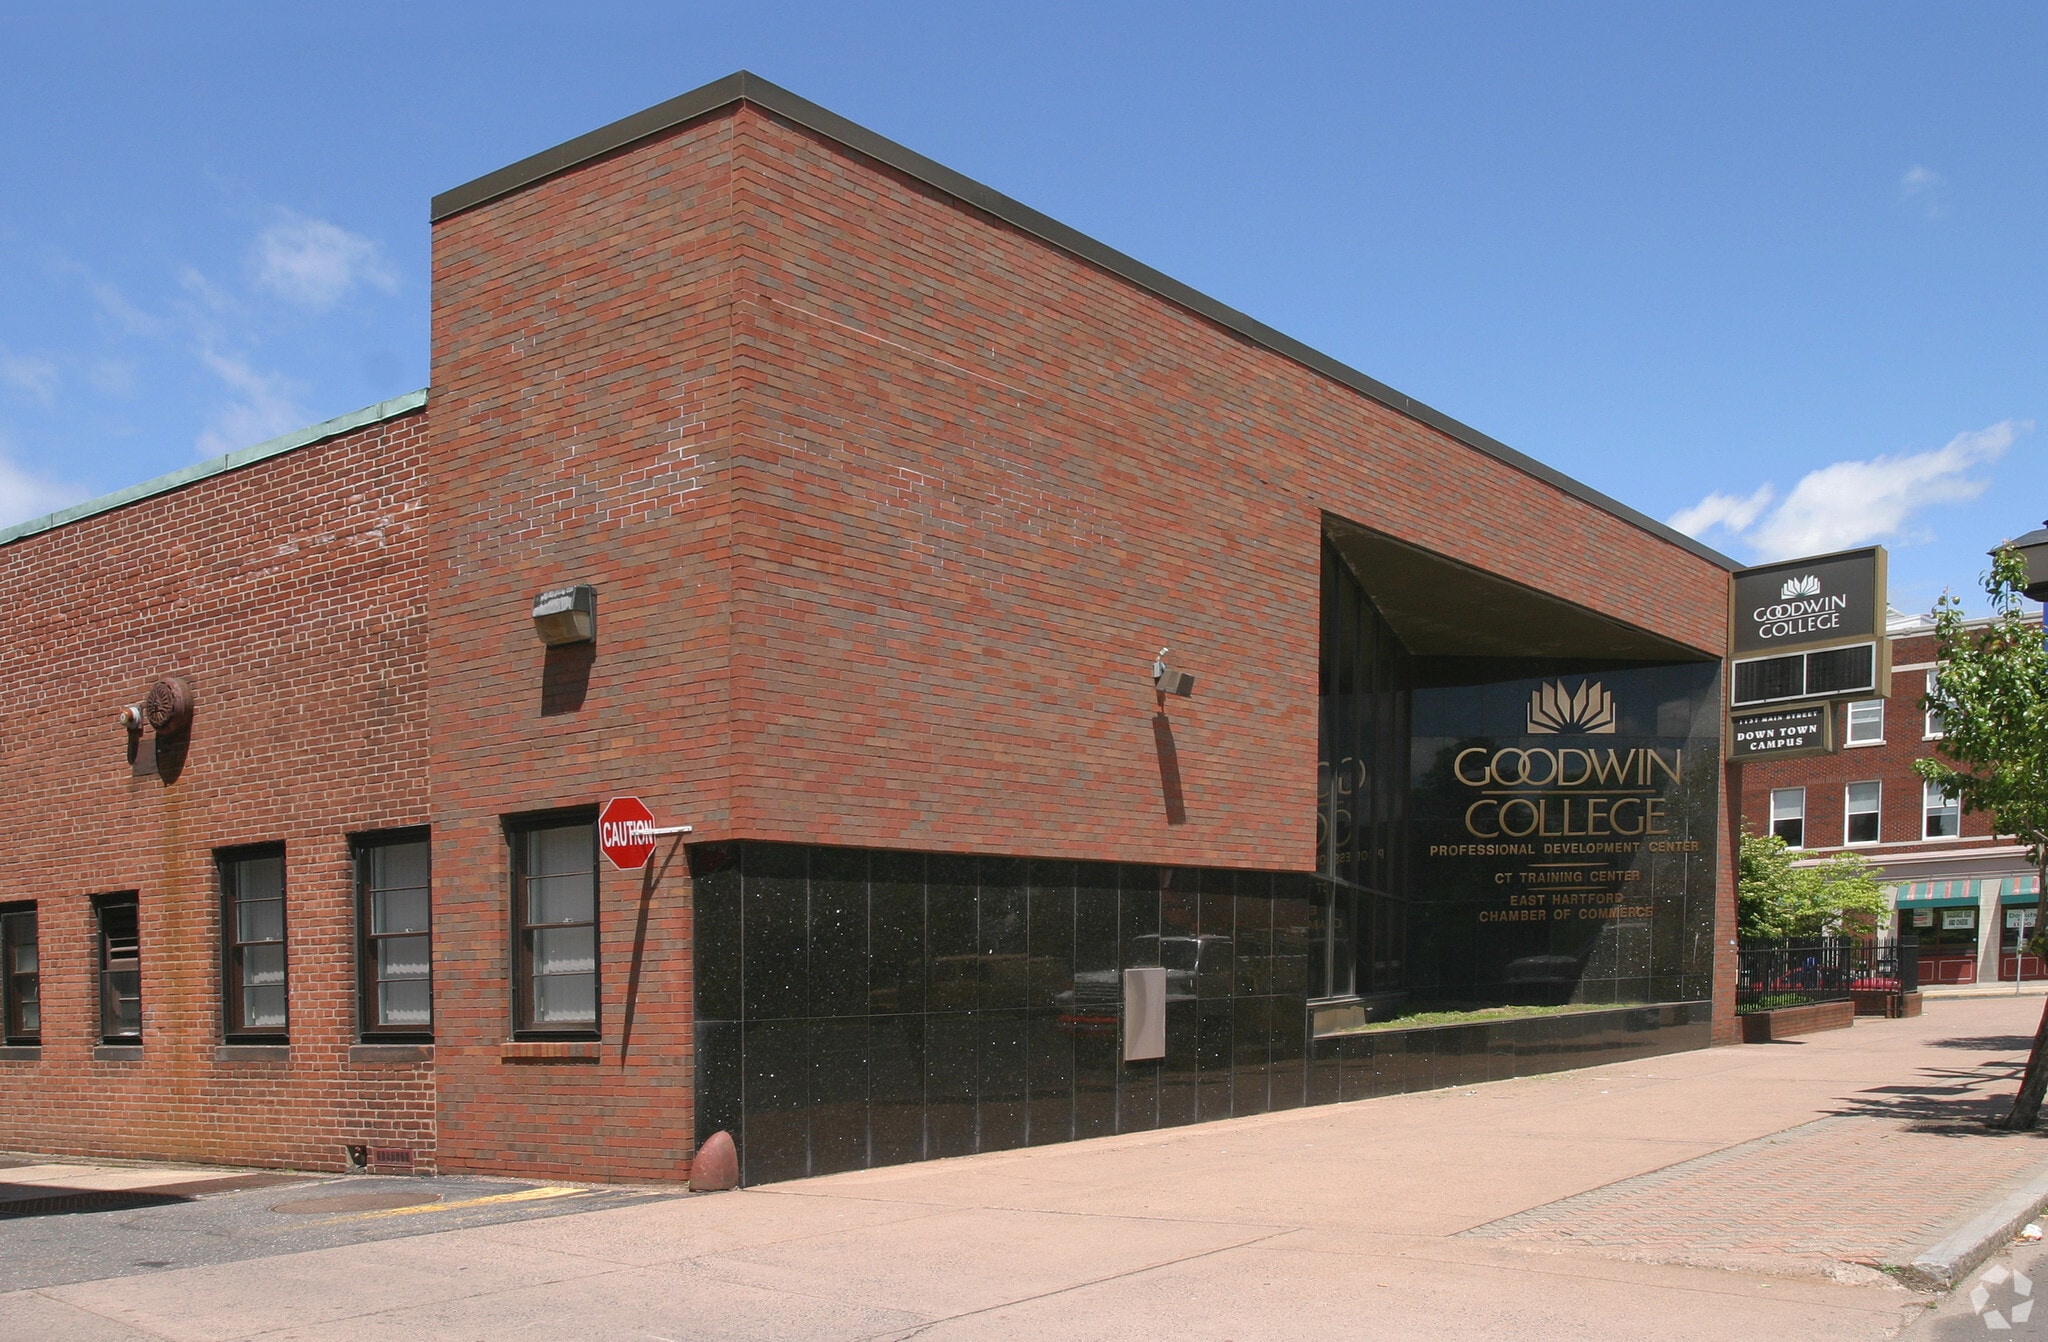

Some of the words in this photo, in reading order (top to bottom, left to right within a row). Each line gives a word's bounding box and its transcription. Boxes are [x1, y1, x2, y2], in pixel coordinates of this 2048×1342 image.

[1753, 593, 1846, 622] GOODWIN
[1759, 613, 1840, 639] COLLEGE
[1761, 715, 1783, 723] MAIN
[1785, 711, 1818, 720] STREET
[1737, 729, 1775, 741] DOWN
[1780, 724, 1817, 736] TOWN
[1750, 737, 1803, 751] CAMPUS
[1454, 747, 1681, 787] GOODWIN
[1465, 798, 1669, 838] COLLEGE
[603, 820, 653, 847] CAUTION
[1429, 843, 1536, 857] PROFESSIONAL
[1543, 841, 1640, 855] DEVELOPMENT
[1648, 841, 1700, 853] CENTER
[1494, 872, 1513, 884] CT
[1519, 871, 1583, 883] TRAINING
[1589, 870, 1641, 882] CENTER
[1510, 894, 1546, 906] EAST
[1552, 893, 1624, 905] HARTFORD
[1479, 909, 1546, 922] CHAMBER
[1553, 908, 1571, 920] OF
[1578, 906, 1654, 920] COMMERCE
